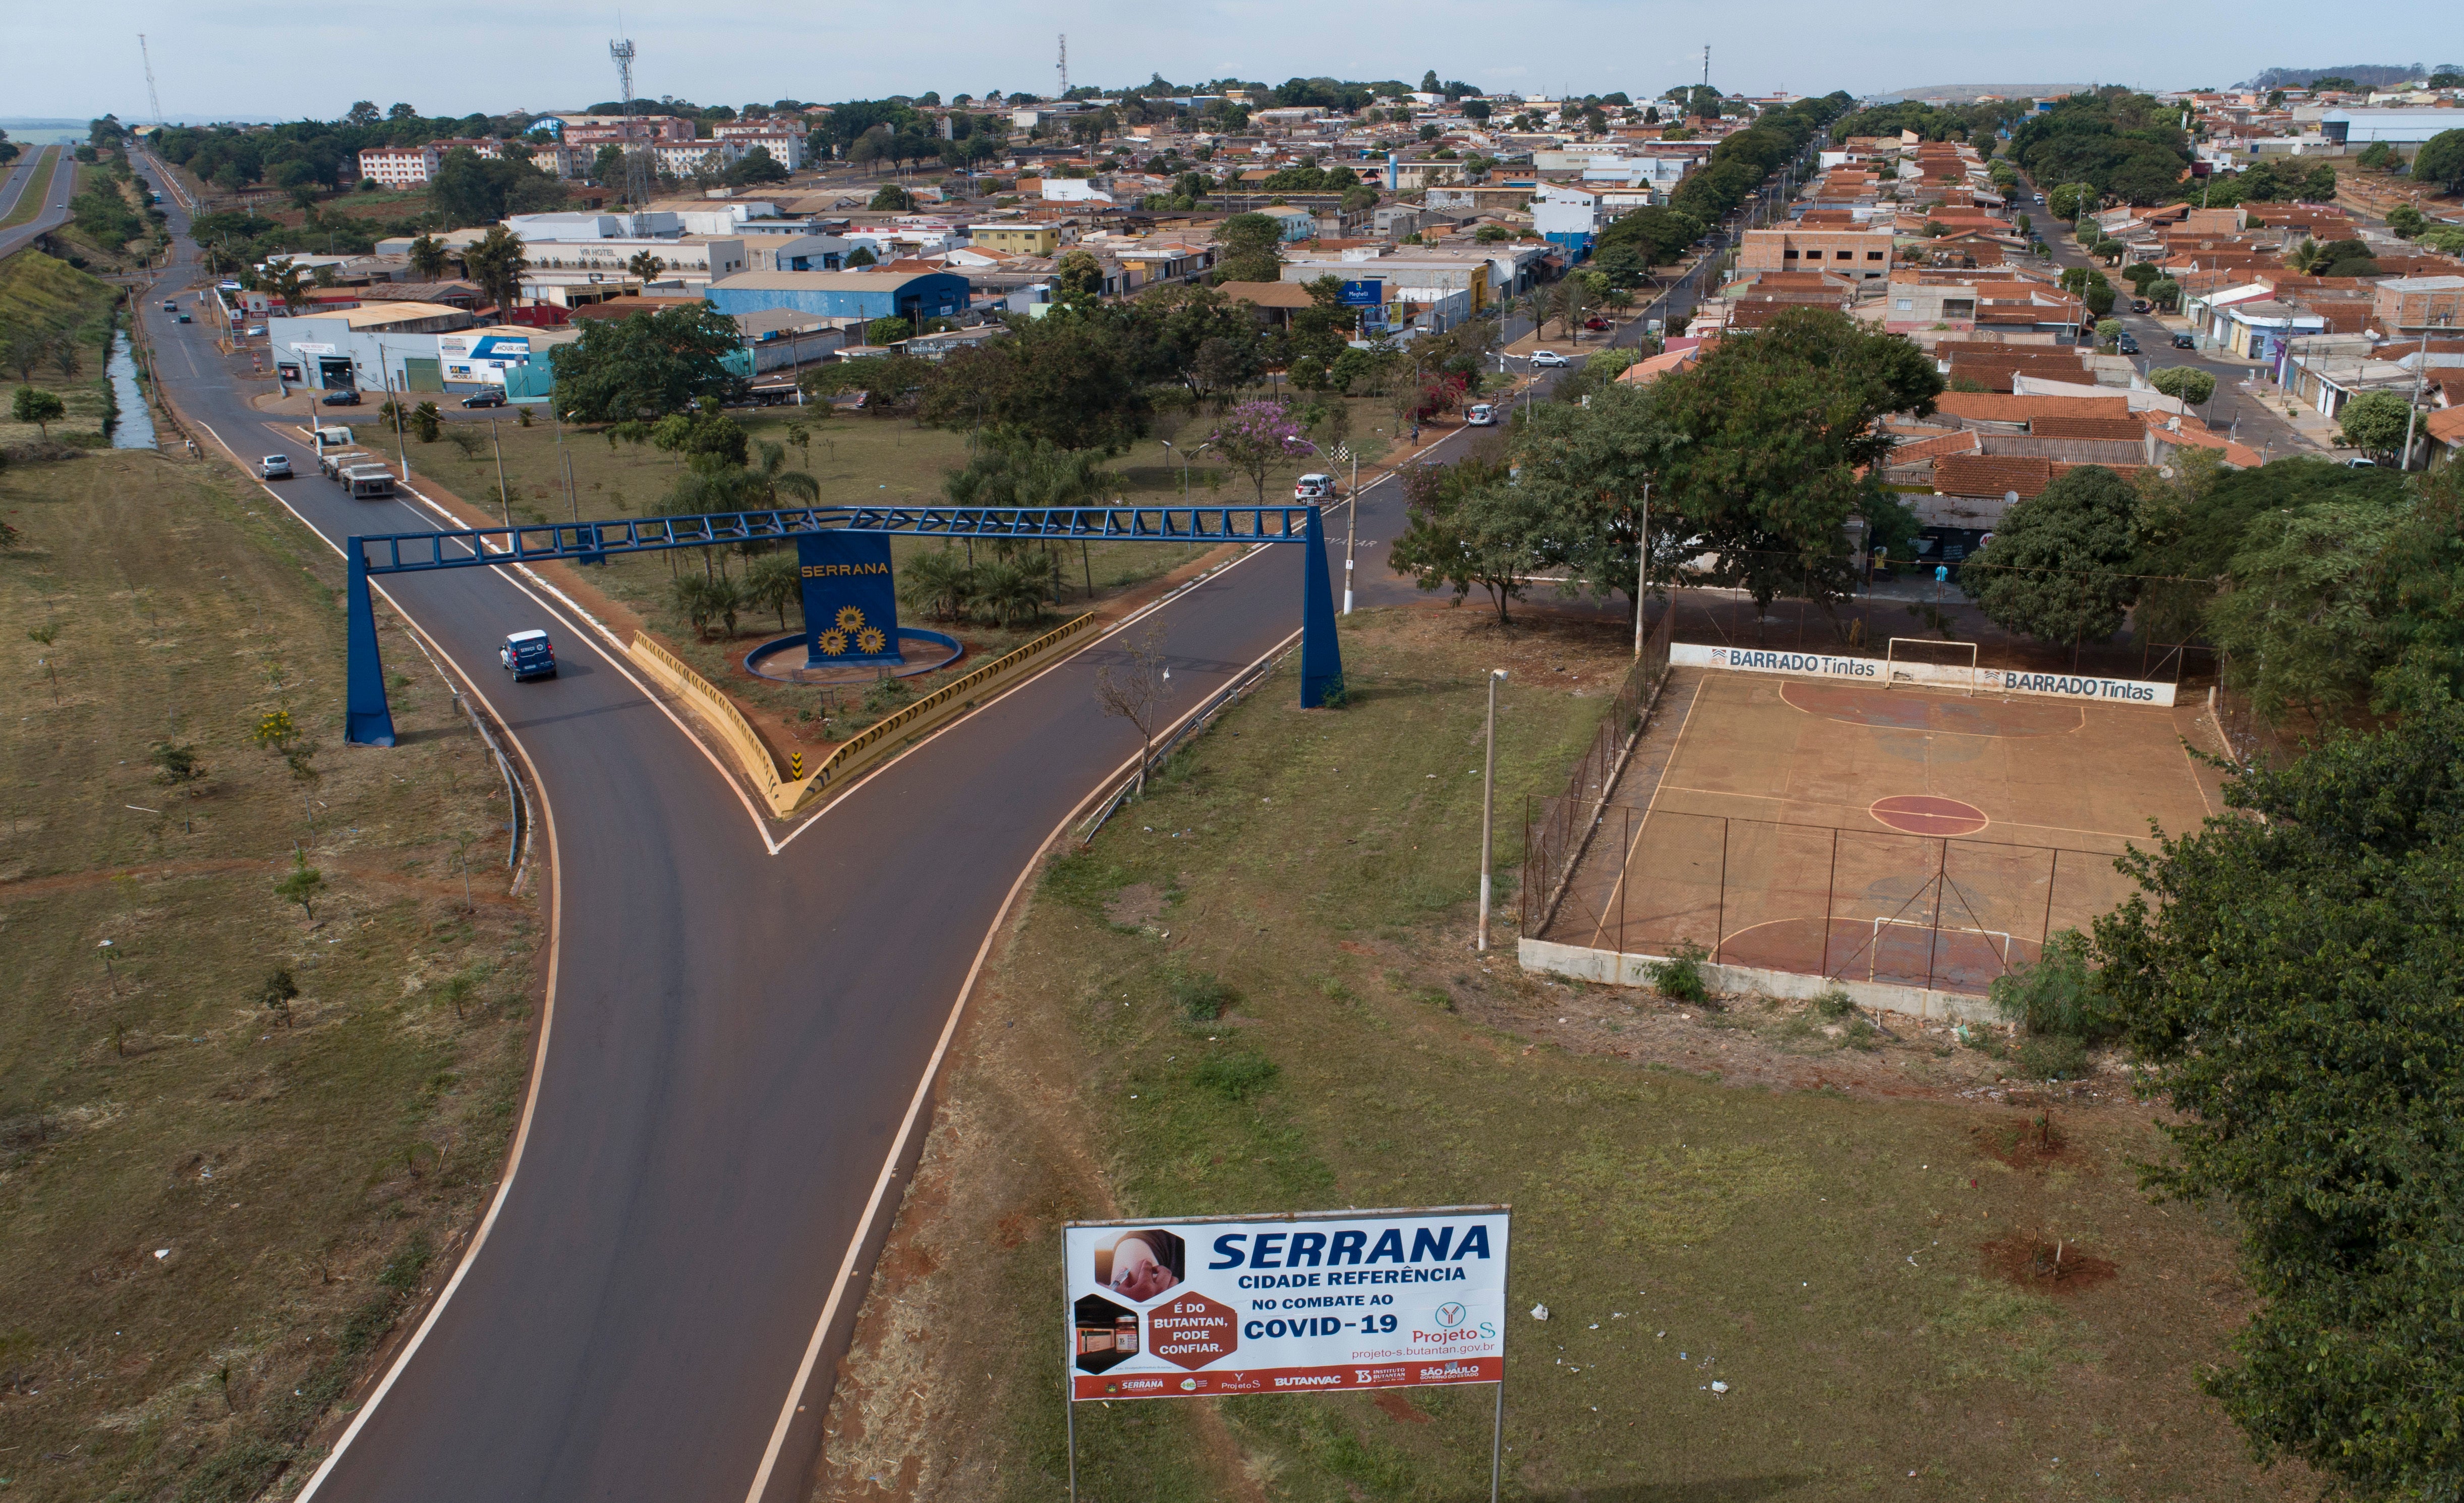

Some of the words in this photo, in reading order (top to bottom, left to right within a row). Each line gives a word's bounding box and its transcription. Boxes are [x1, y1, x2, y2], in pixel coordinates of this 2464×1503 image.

[801, 563, 888, 577] SERRANA
[1731, 650, 1818, 672] BARRADO
[1822, 657, 1874, 677] Tintas
[2005, 673, 2097, 695] BARRADO
[2100, 680, 2153, 700] Tintas
[1209, 1225, 1490, 1269] SERRANA
[1238, 1273, 1321, 1289] CIDADE
[1328, 1266, 1466, 1286] REFERÊNCIA
[1174, 1302, 1182, 1313] É
[1187, 1303, 1205, 1313] DO
[1252, 1299, 1277, 1310] NO
[1282, 1295, 1365, 1309] COMBATE
[1370, 1294, 1394, 1306] AO
[1154, 1317, 1228, 1328] BUTANTAN,
[1244, 1314, 1398, 1340] COVID-19
[1173, 1330, 1210, 1341] PODE
[1413, 1328, 1477, 1345] Projeto
[1480, 1322, 1496, 1339] S
[1159, 1343, 1223, 1355] CONFIAR.
[1352, 1343, 1495, 1359] projeto-s.butantan.gov.br
[1420, 1367, 1443, 1376] SÃO
[1444, 1365, 1479, 1375] PAULO
[1122, 1380, 1163, 1389] SERRANA
[1252, 1380, 1260, 1388] S
[1274, 1375, 1341, 1386] BUTANVAC
